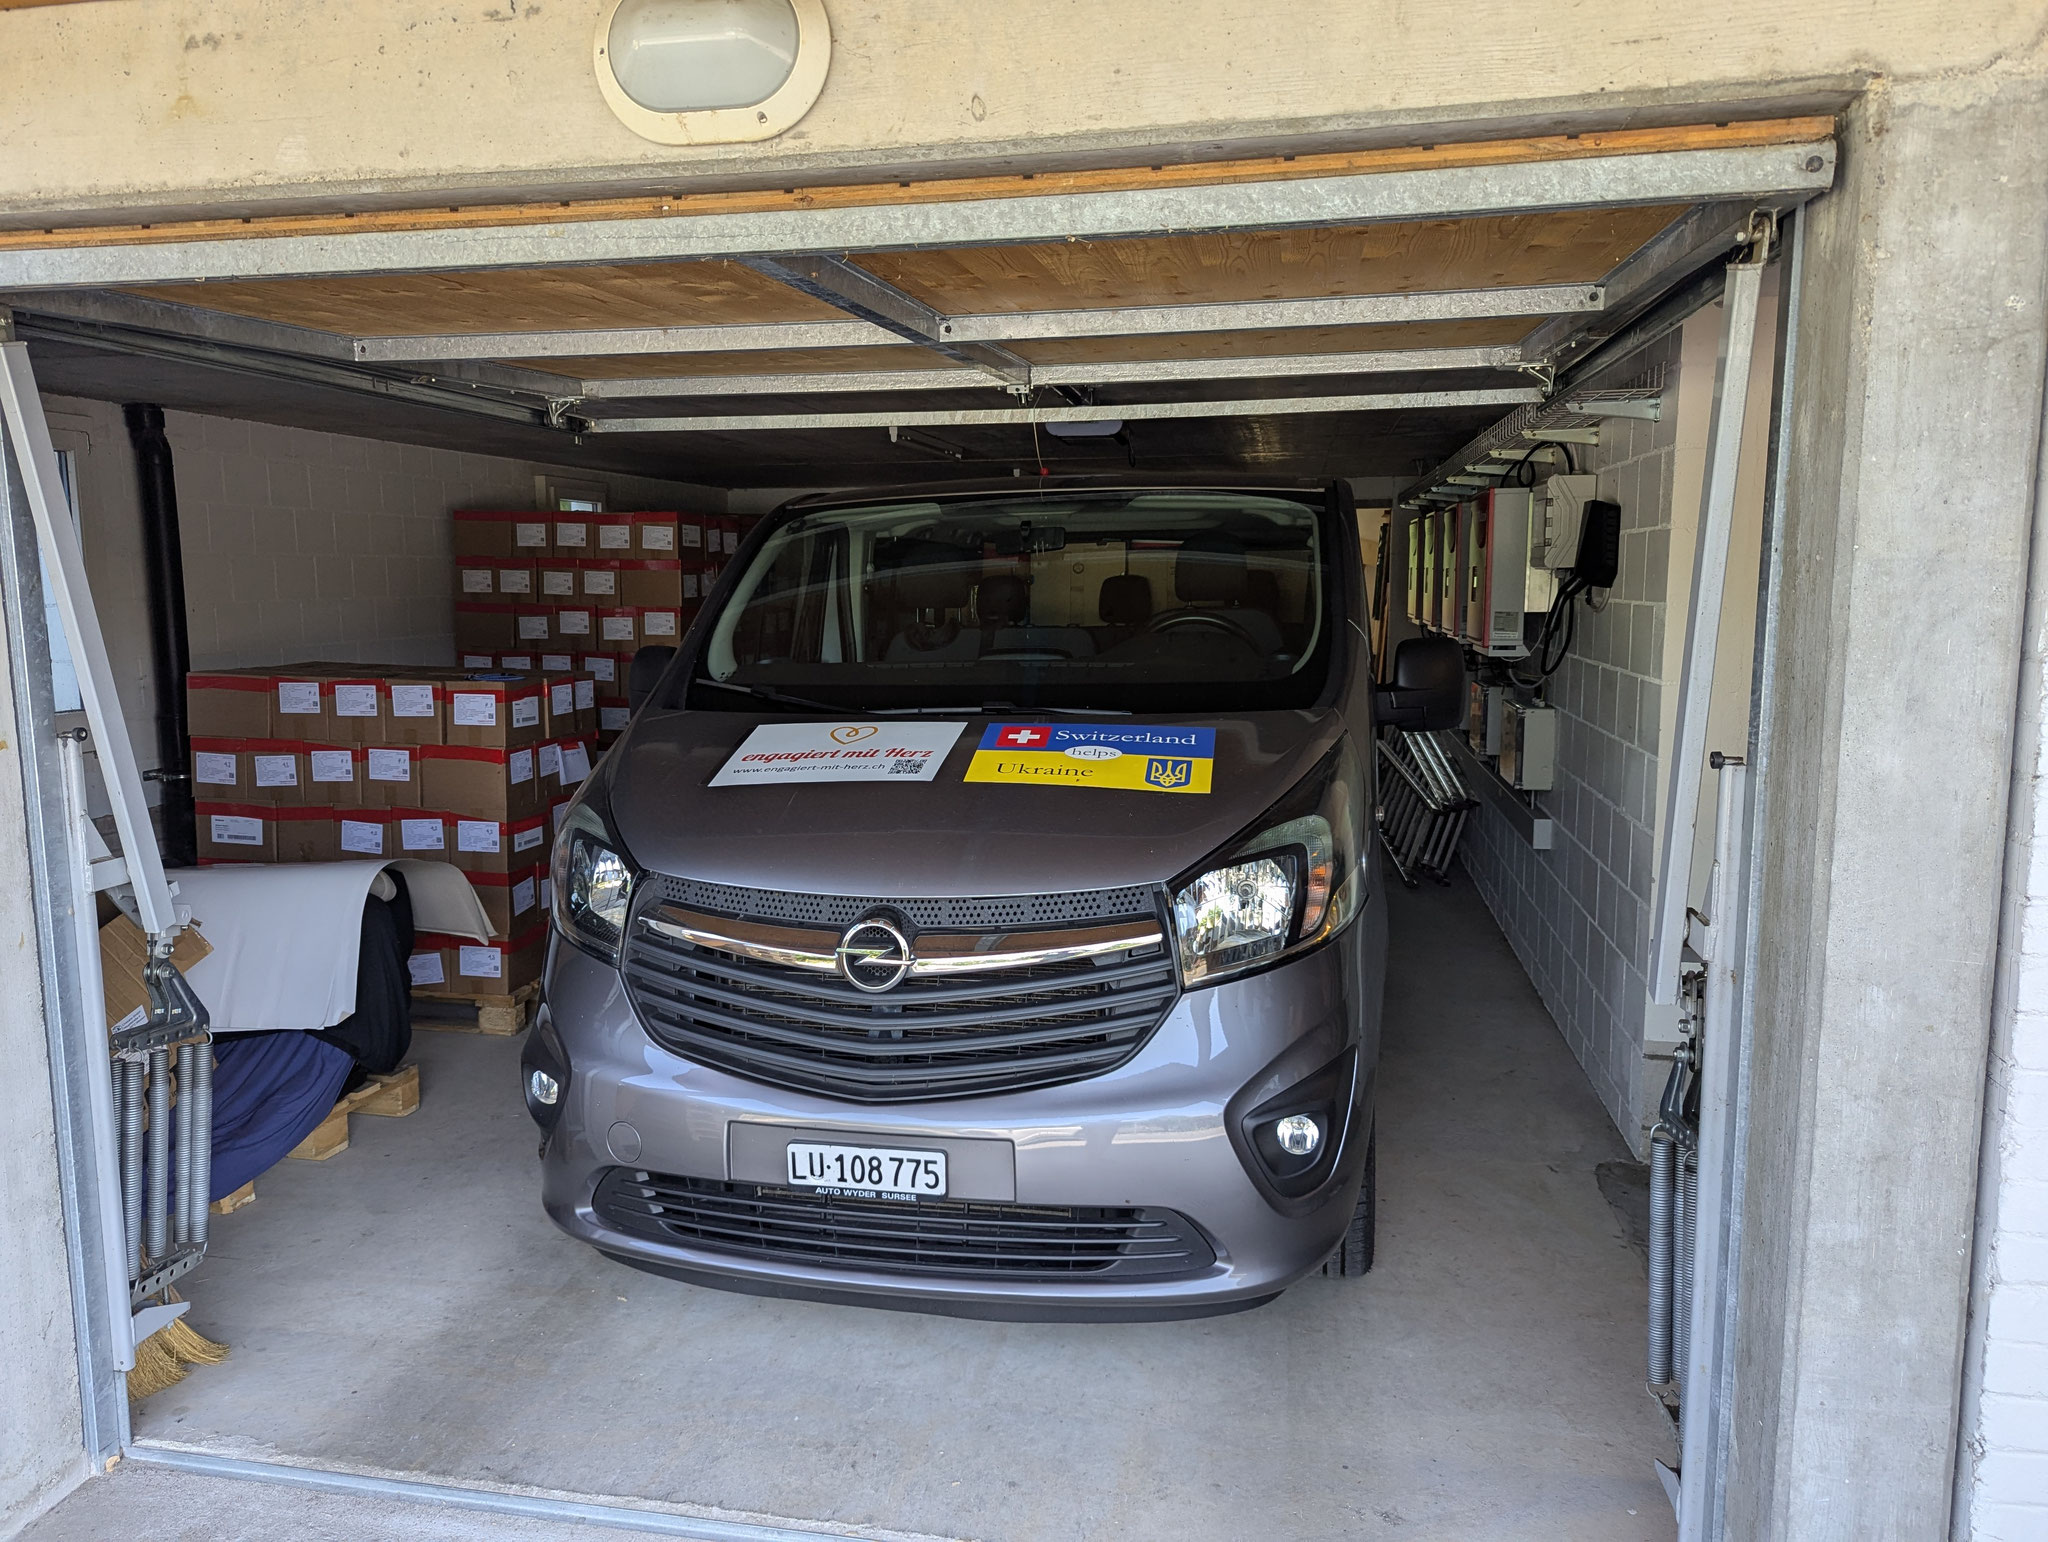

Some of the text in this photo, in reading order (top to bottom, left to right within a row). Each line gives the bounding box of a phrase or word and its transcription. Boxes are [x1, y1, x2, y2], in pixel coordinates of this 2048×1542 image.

[1055, 730, 1197, 745] Switzerland
[741, 747, 934, 763] engagiert mit Herz
[1072, 748, 1117, 758] helps
[733, 763, 886, 774] www.engagiert-mit-herz.ch
[997, 763, 1094, 776] Ukraine
[815, 1186, 917, 1201] AUTO WYDER SURSEE
